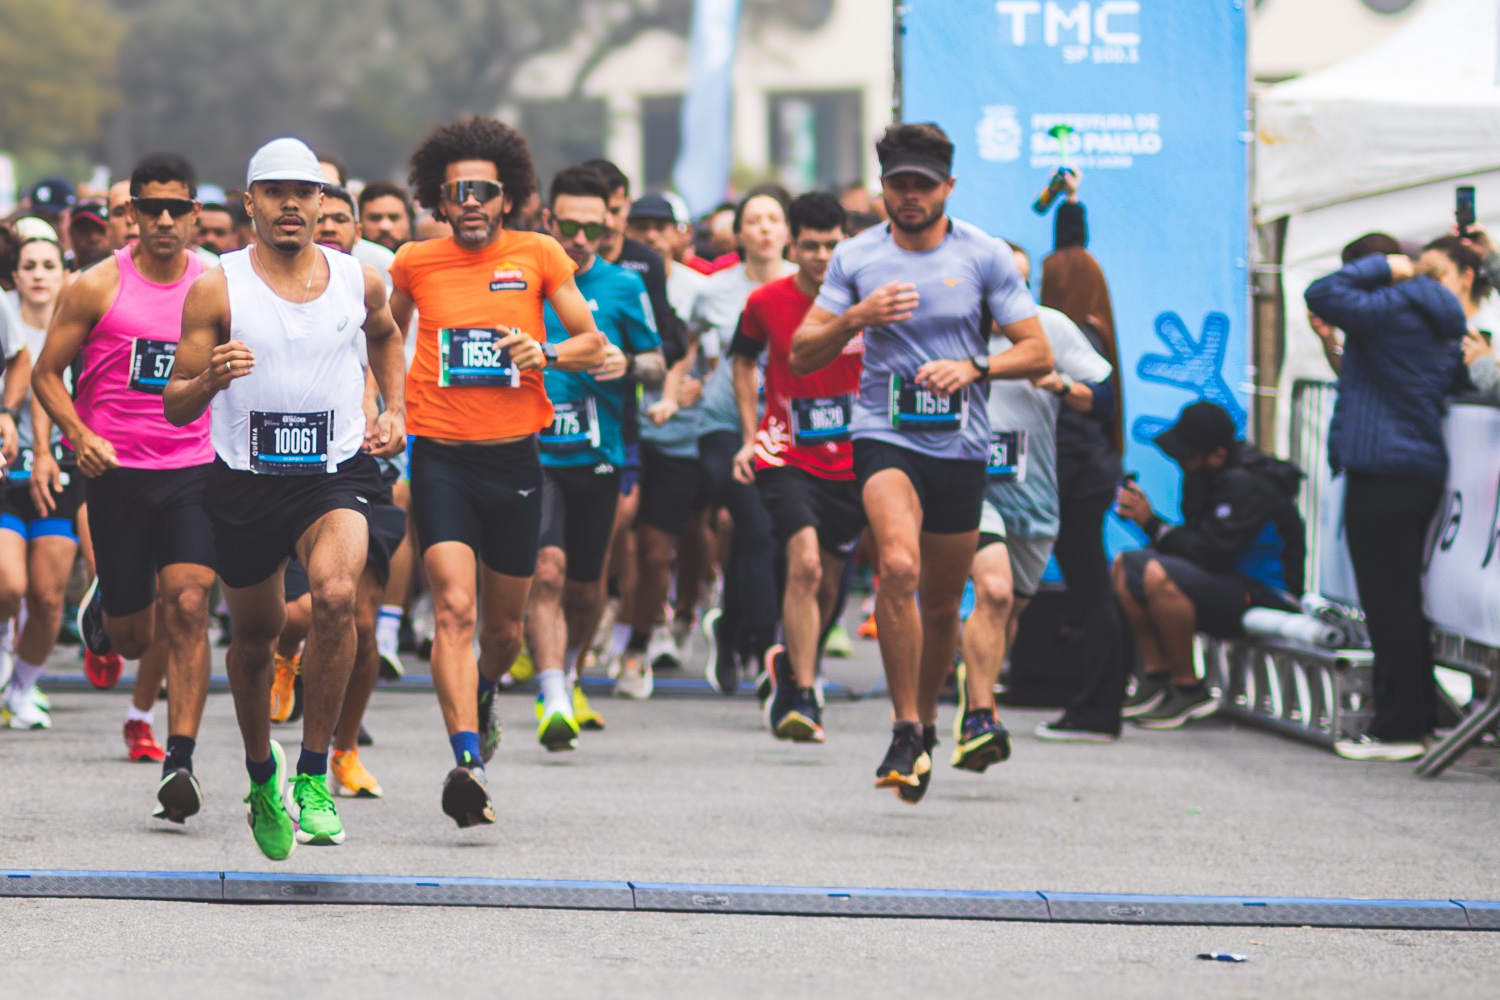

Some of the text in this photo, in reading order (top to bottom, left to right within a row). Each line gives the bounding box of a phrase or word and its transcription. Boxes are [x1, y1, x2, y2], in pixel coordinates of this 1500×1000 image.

[995, 0, 1141, 47] TMC
[1083, 132, 1163, 156] PAULO
[153, 354, 176, 378] 57
[274, 427, 318, 454] 10061
